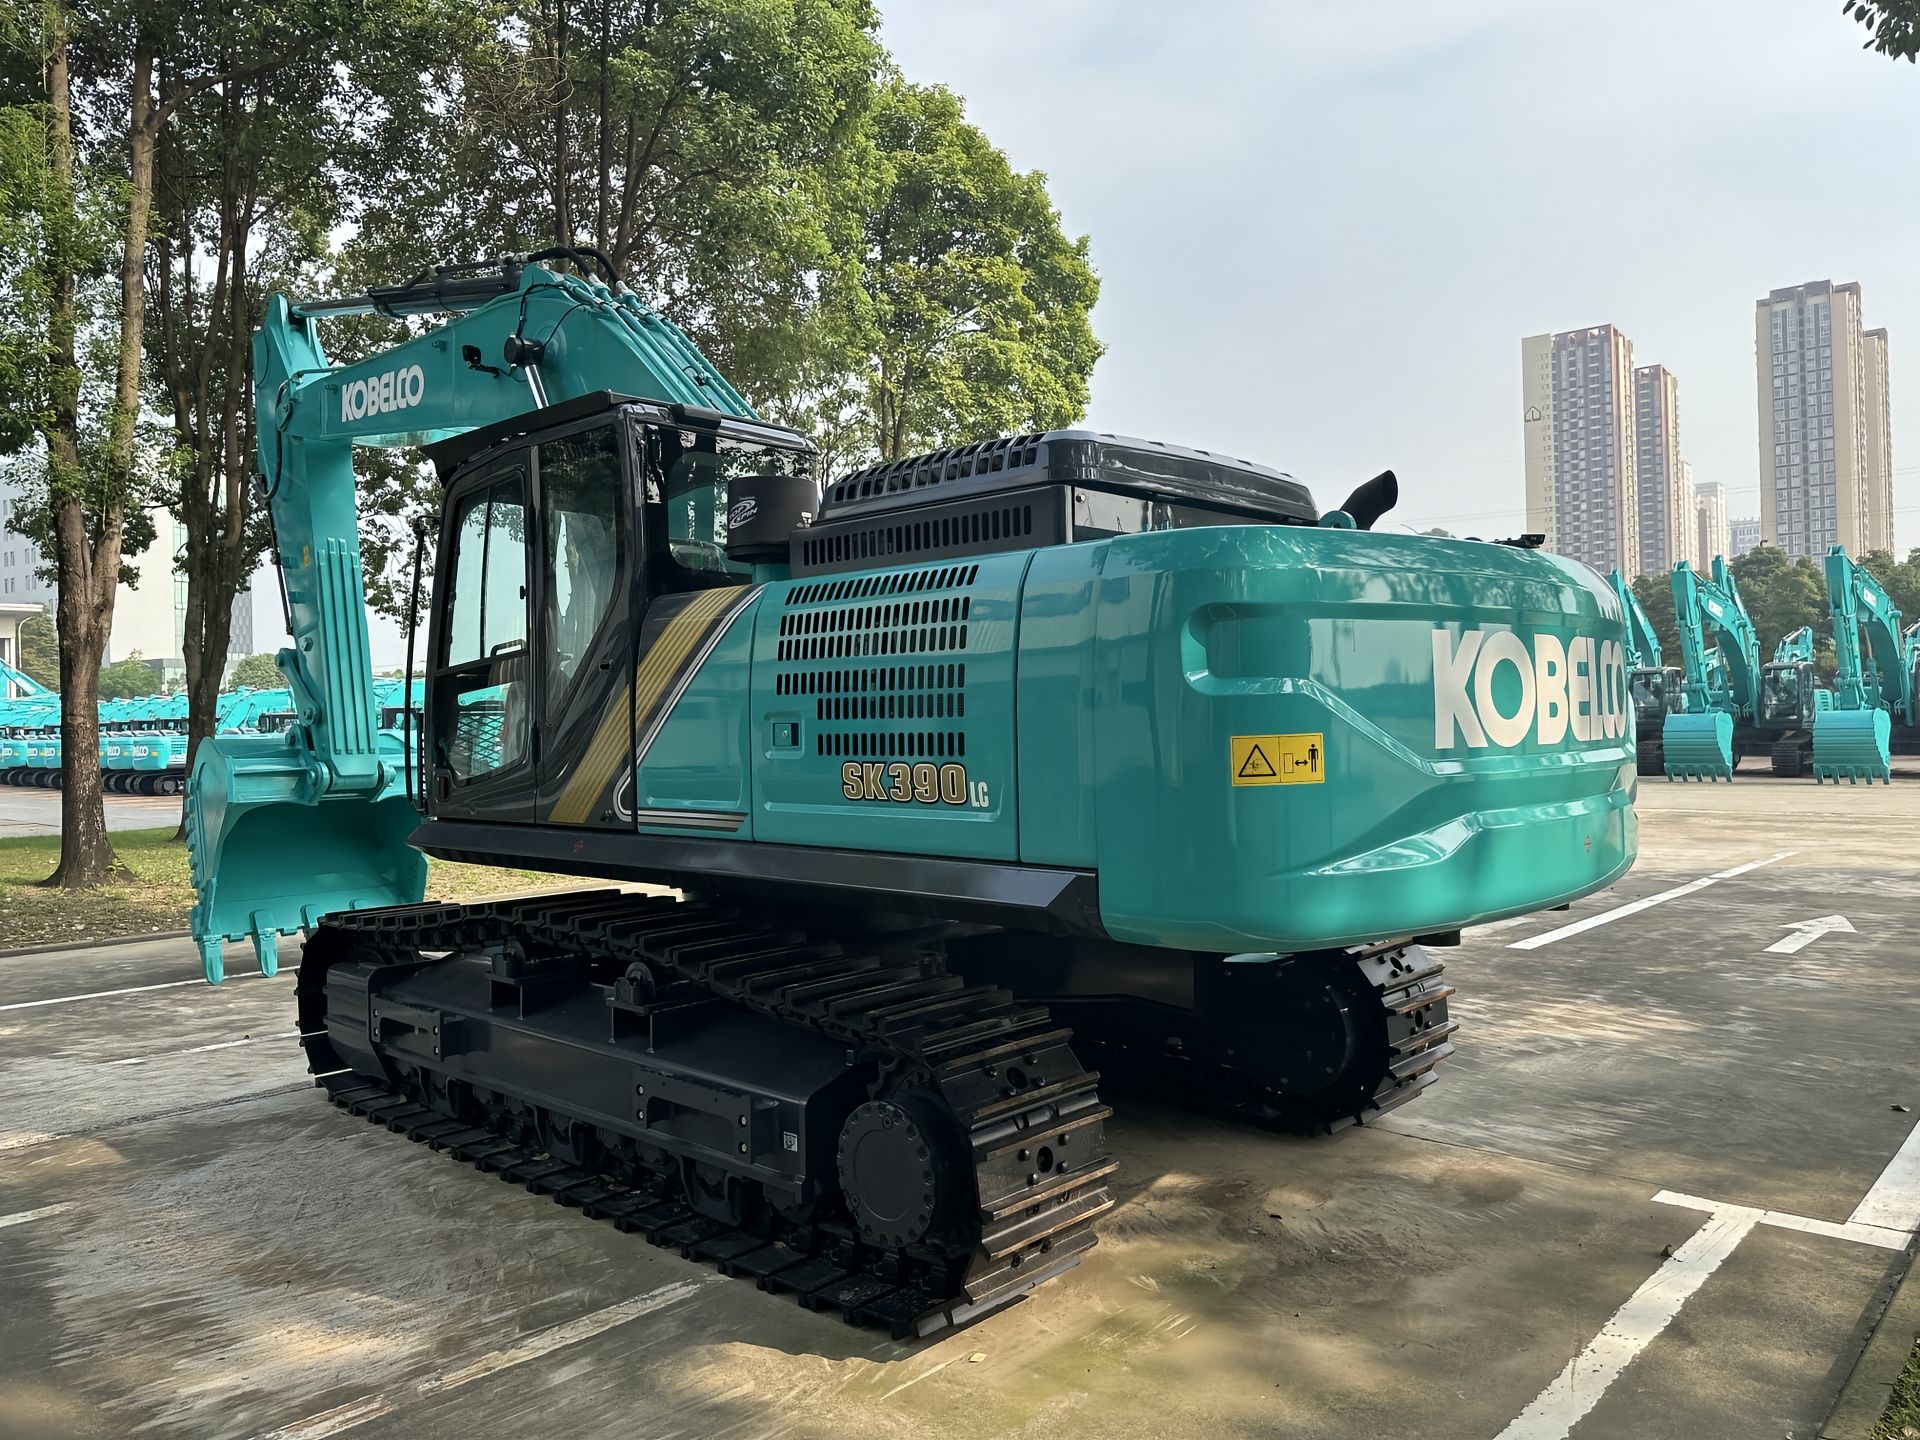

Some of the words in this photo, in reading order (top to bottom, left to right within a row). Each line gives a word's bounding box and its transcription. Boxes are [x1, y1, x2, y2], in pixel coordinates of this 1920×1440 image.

[341, 364, 425, 423] KOBELCO
[736, 507, 758, 522] SPIN
[1431, 629, 1628, 750] KOBELCO
